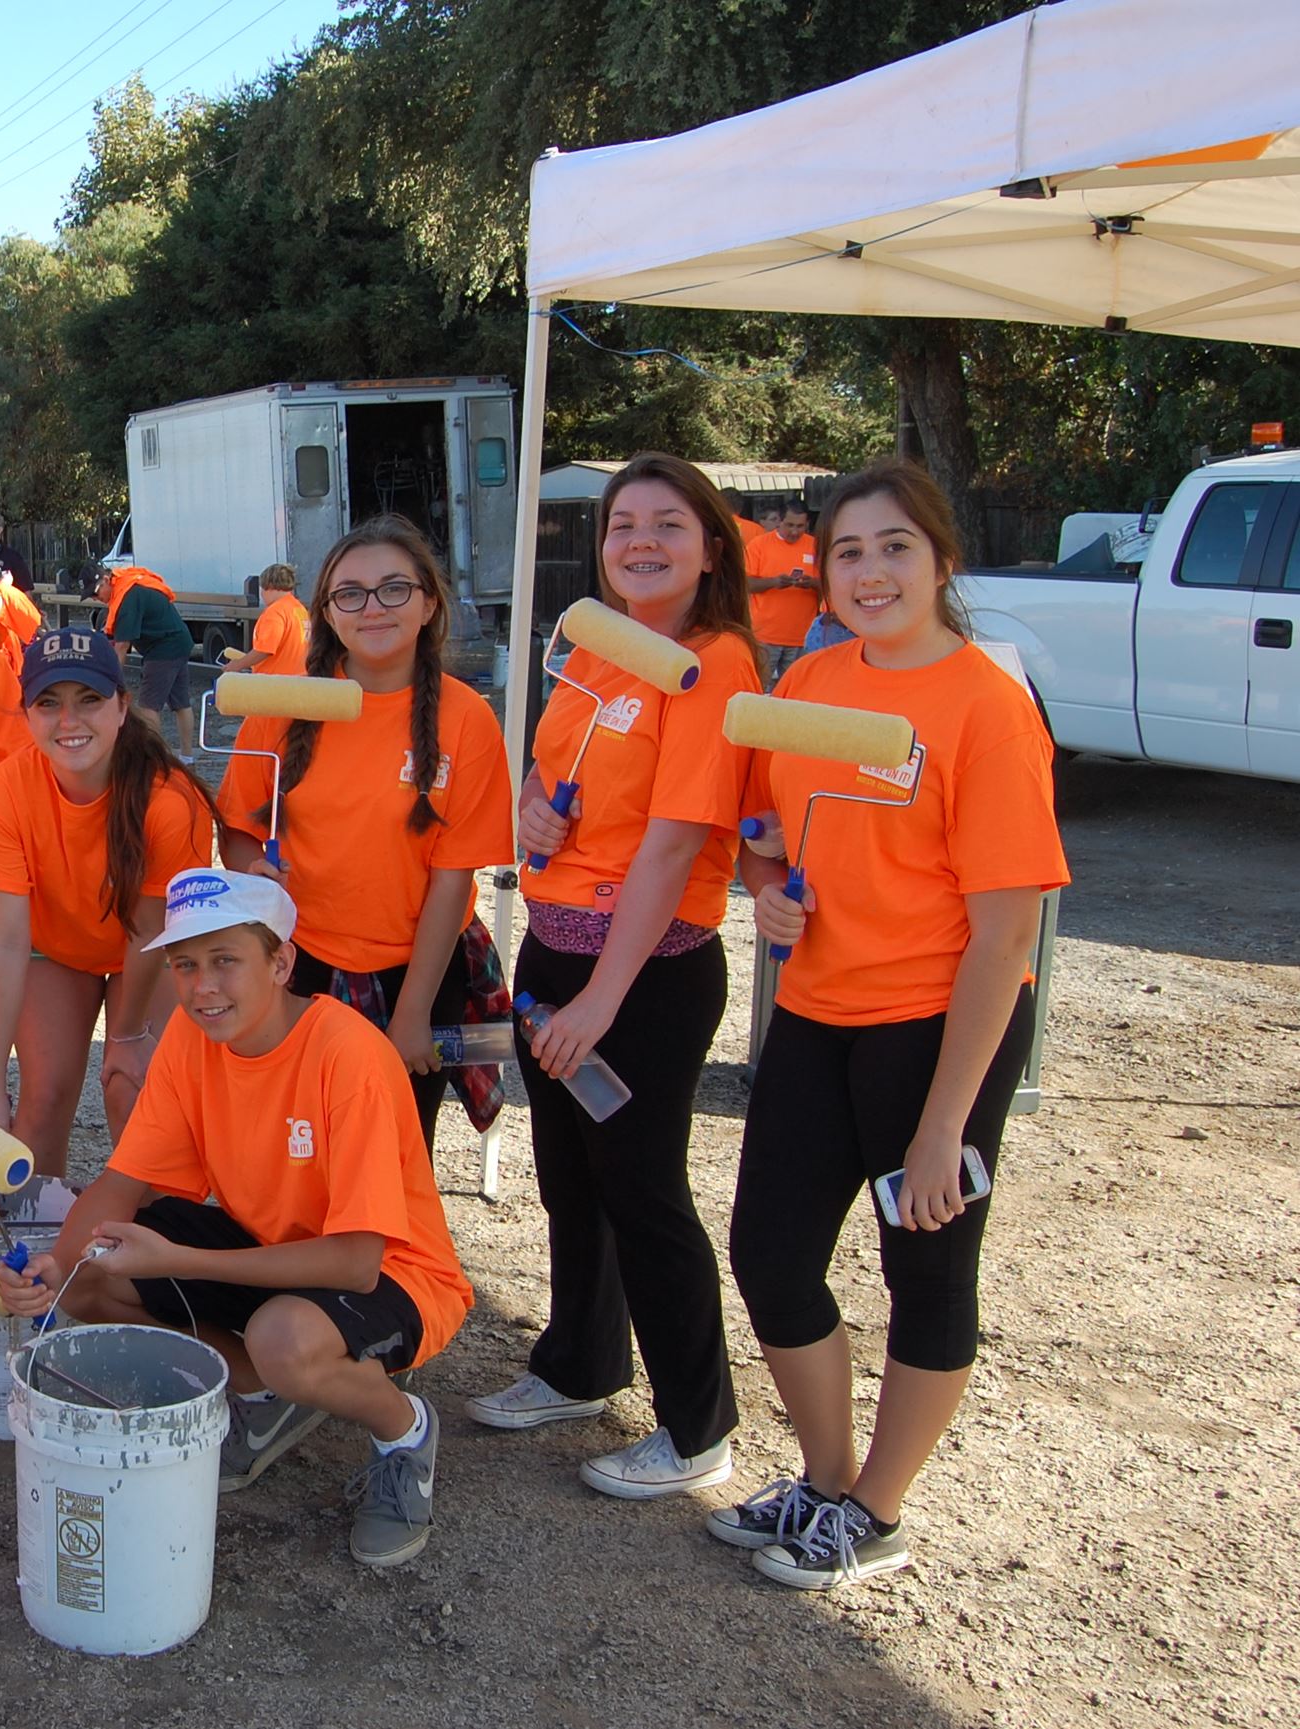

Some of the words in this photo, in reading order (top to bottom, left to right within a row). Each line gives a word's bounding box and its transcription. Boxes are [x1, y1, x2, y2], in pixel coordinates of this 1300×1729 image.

[43, 634, 60, 656] G
[70, 632, 92, 654] U
[886, 768, 898, 780] ON
[899, 771, 911, 785] IT!
